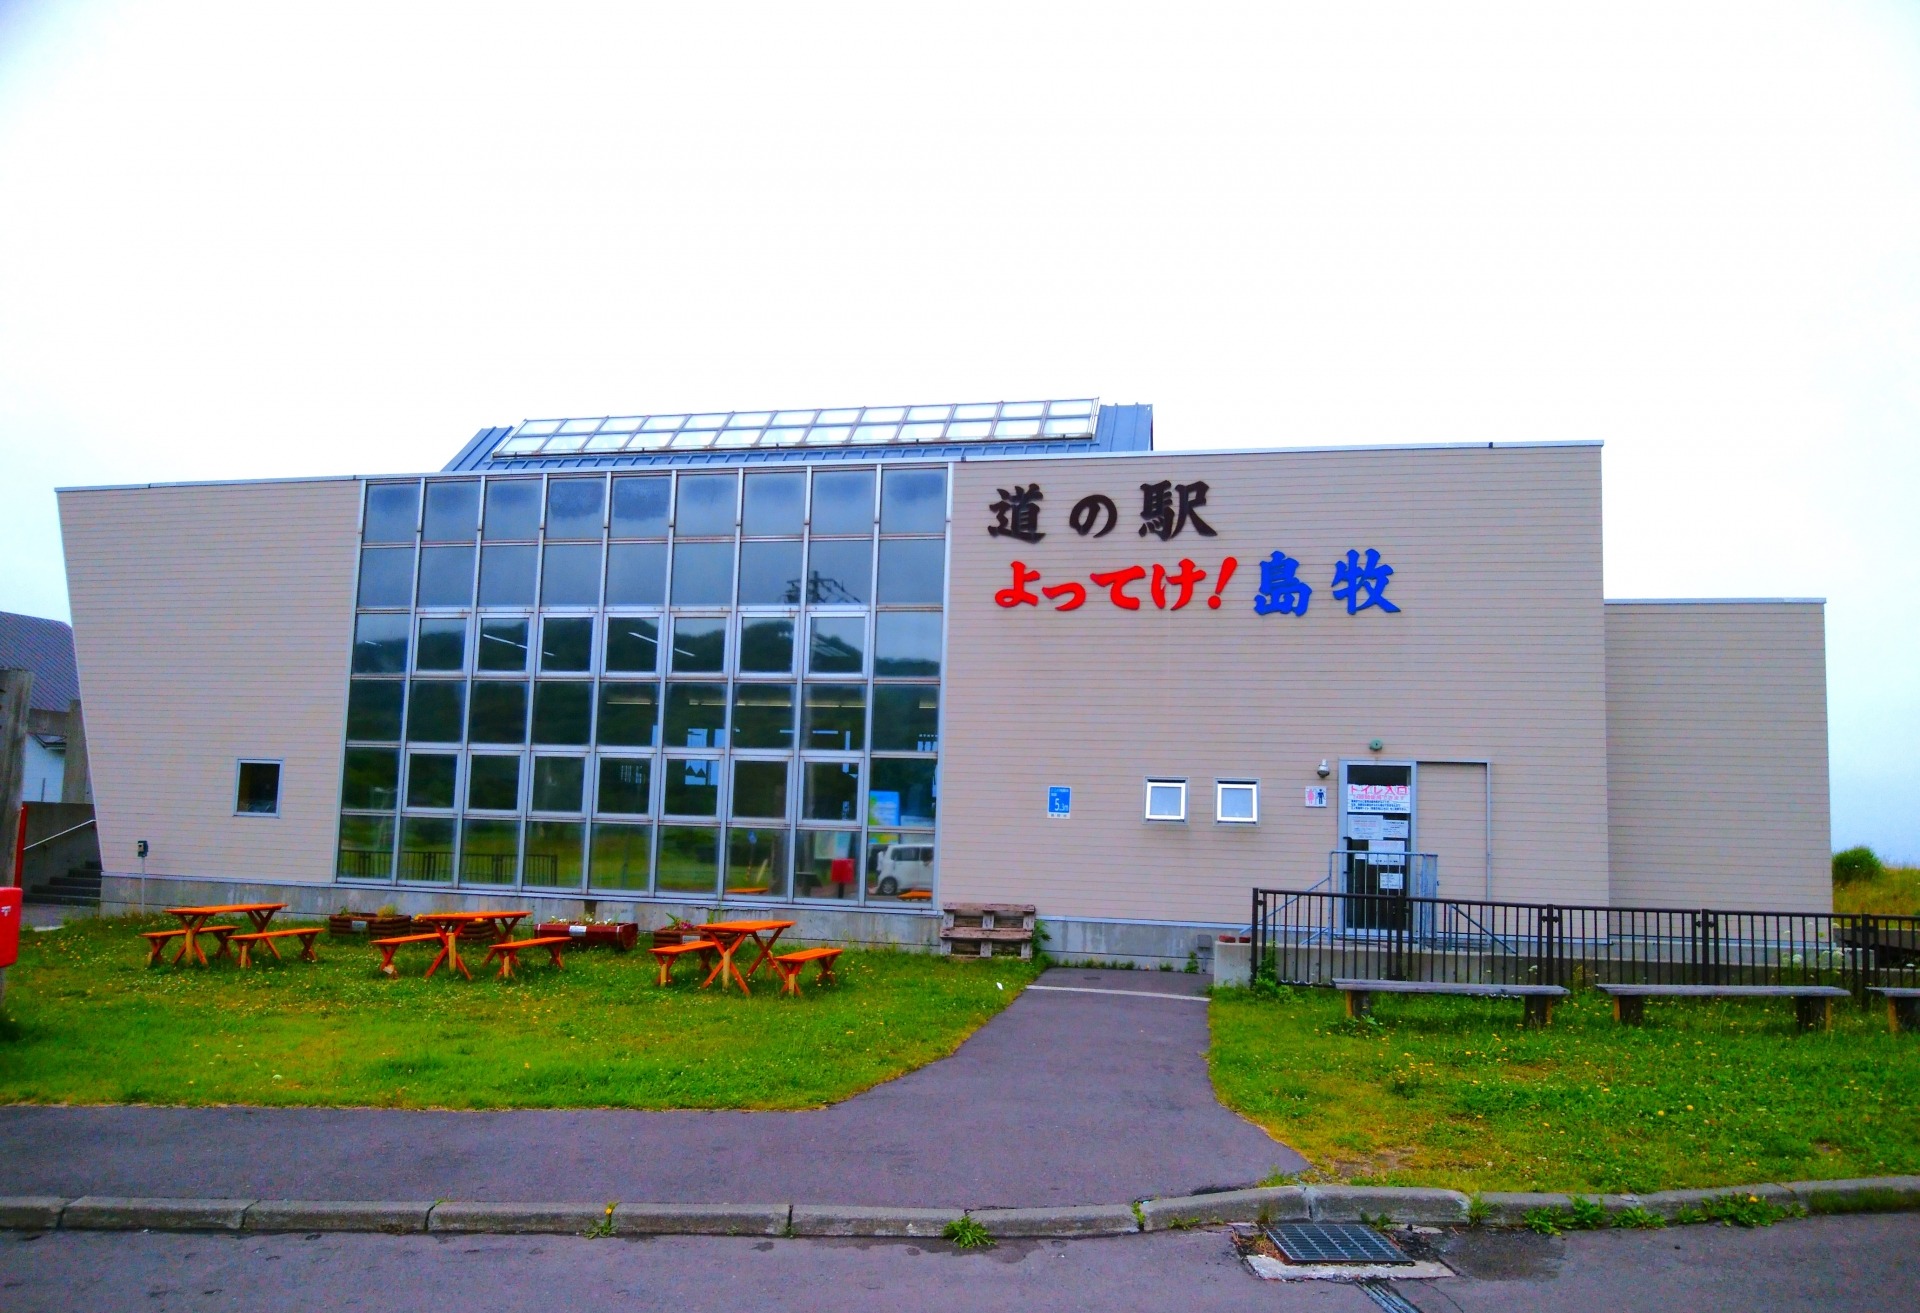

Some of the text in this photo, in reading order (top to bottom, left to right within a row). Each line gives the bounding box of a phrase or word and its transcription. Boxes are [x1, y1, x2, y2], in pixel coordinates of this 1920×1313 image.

[988, 480, 1218, 544] 道の駅
[1253, 548, 1400, 617] 島牧
[1350, 784, 1408, 796] トイレ入口
